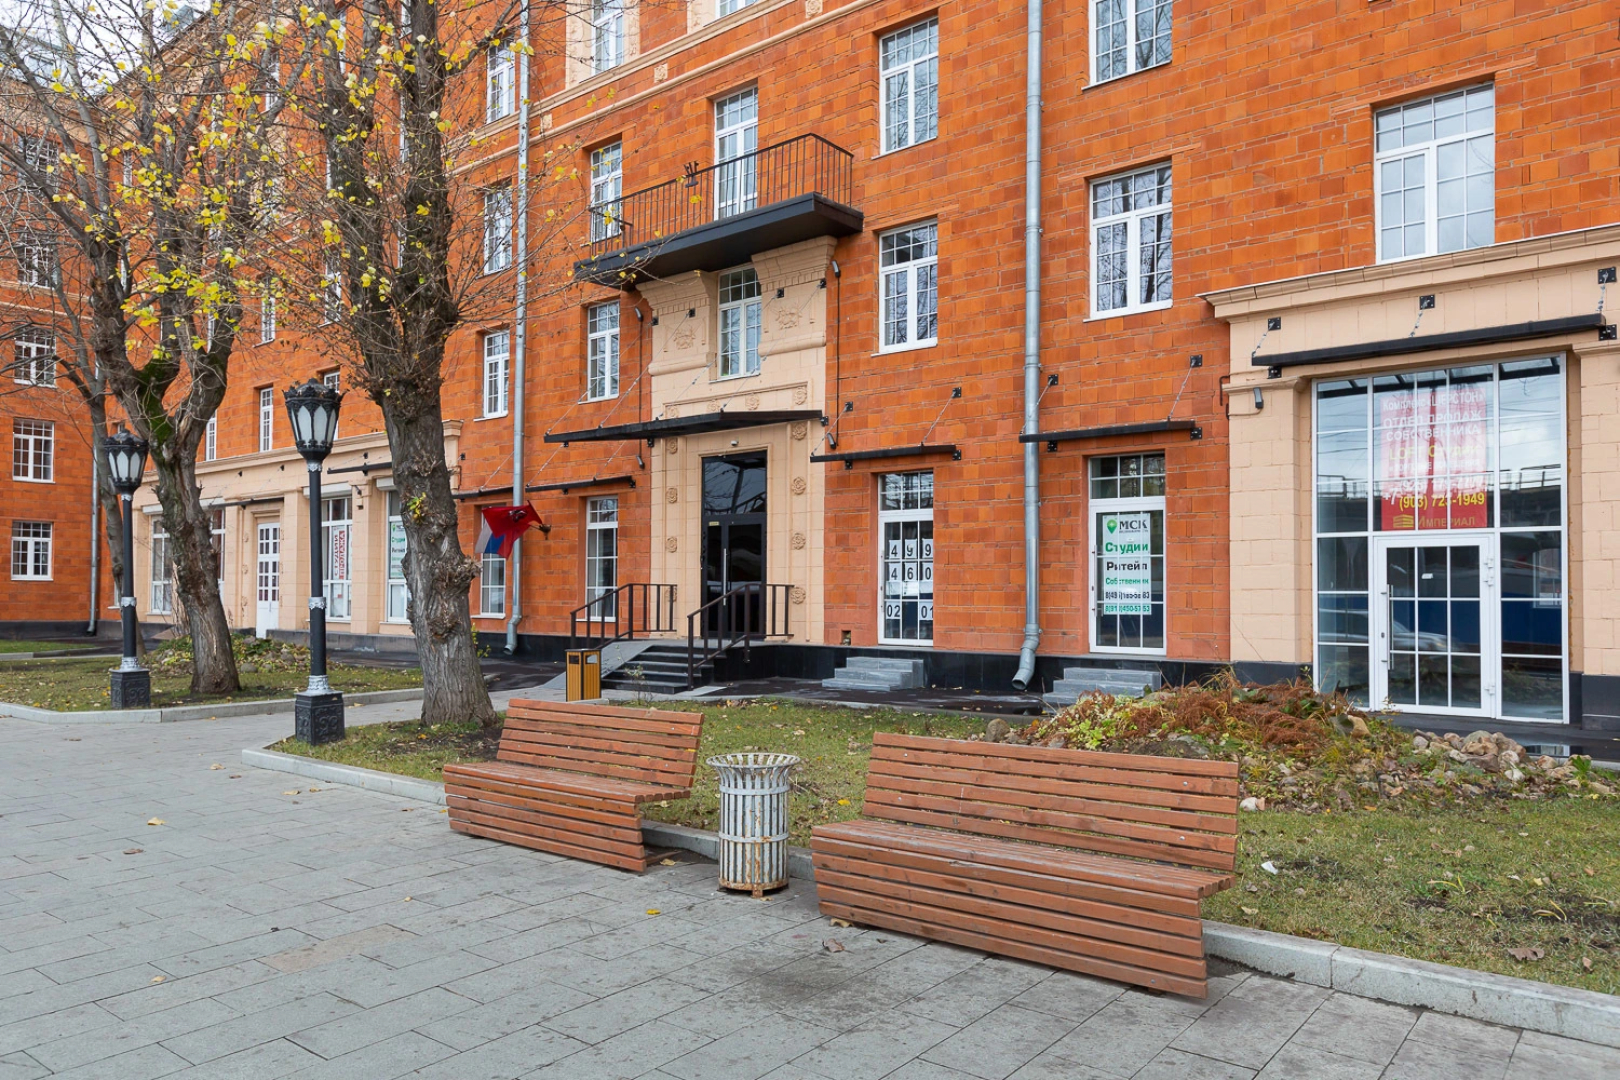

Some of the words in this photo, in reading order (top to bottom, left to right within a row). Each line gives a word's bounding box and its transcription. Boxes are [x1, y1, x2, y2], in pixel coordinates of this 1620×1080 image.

[1119, 520, 1148, 530] МСК
[1105, 542, 1148, 554] Студии
[1106, 560, 1148, 571] Ритейл
[887, 605, 900, 617] 02
